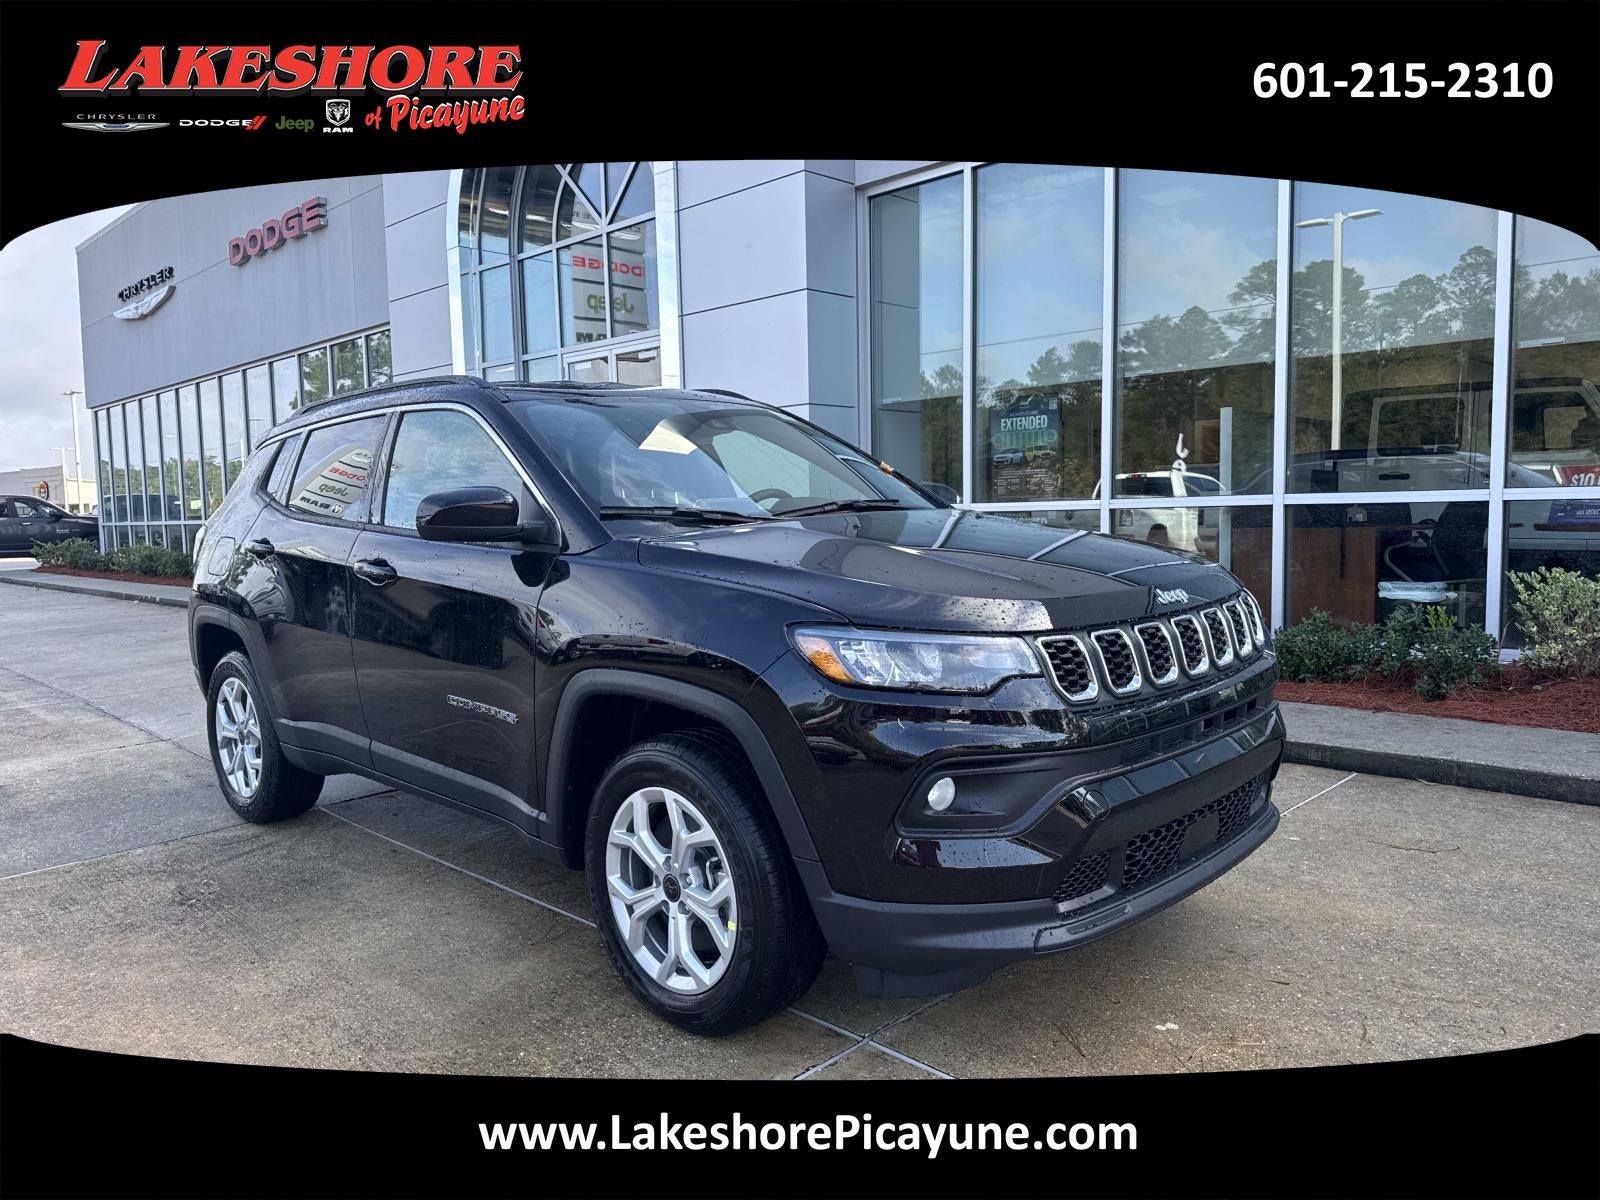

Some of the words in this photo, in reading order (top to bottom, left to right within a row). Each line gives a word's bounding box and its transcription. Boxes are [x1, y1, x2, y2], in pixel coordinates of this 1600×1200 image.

[228, 196, 328, 266] DODGE
[118, 266, 174, 302] CHRYSLER
[1001, 414, 1048, 431] EXTENDED
[1155, 588, 1189, 605] Jeep
[446, 694, 519, 725] COMPASS
